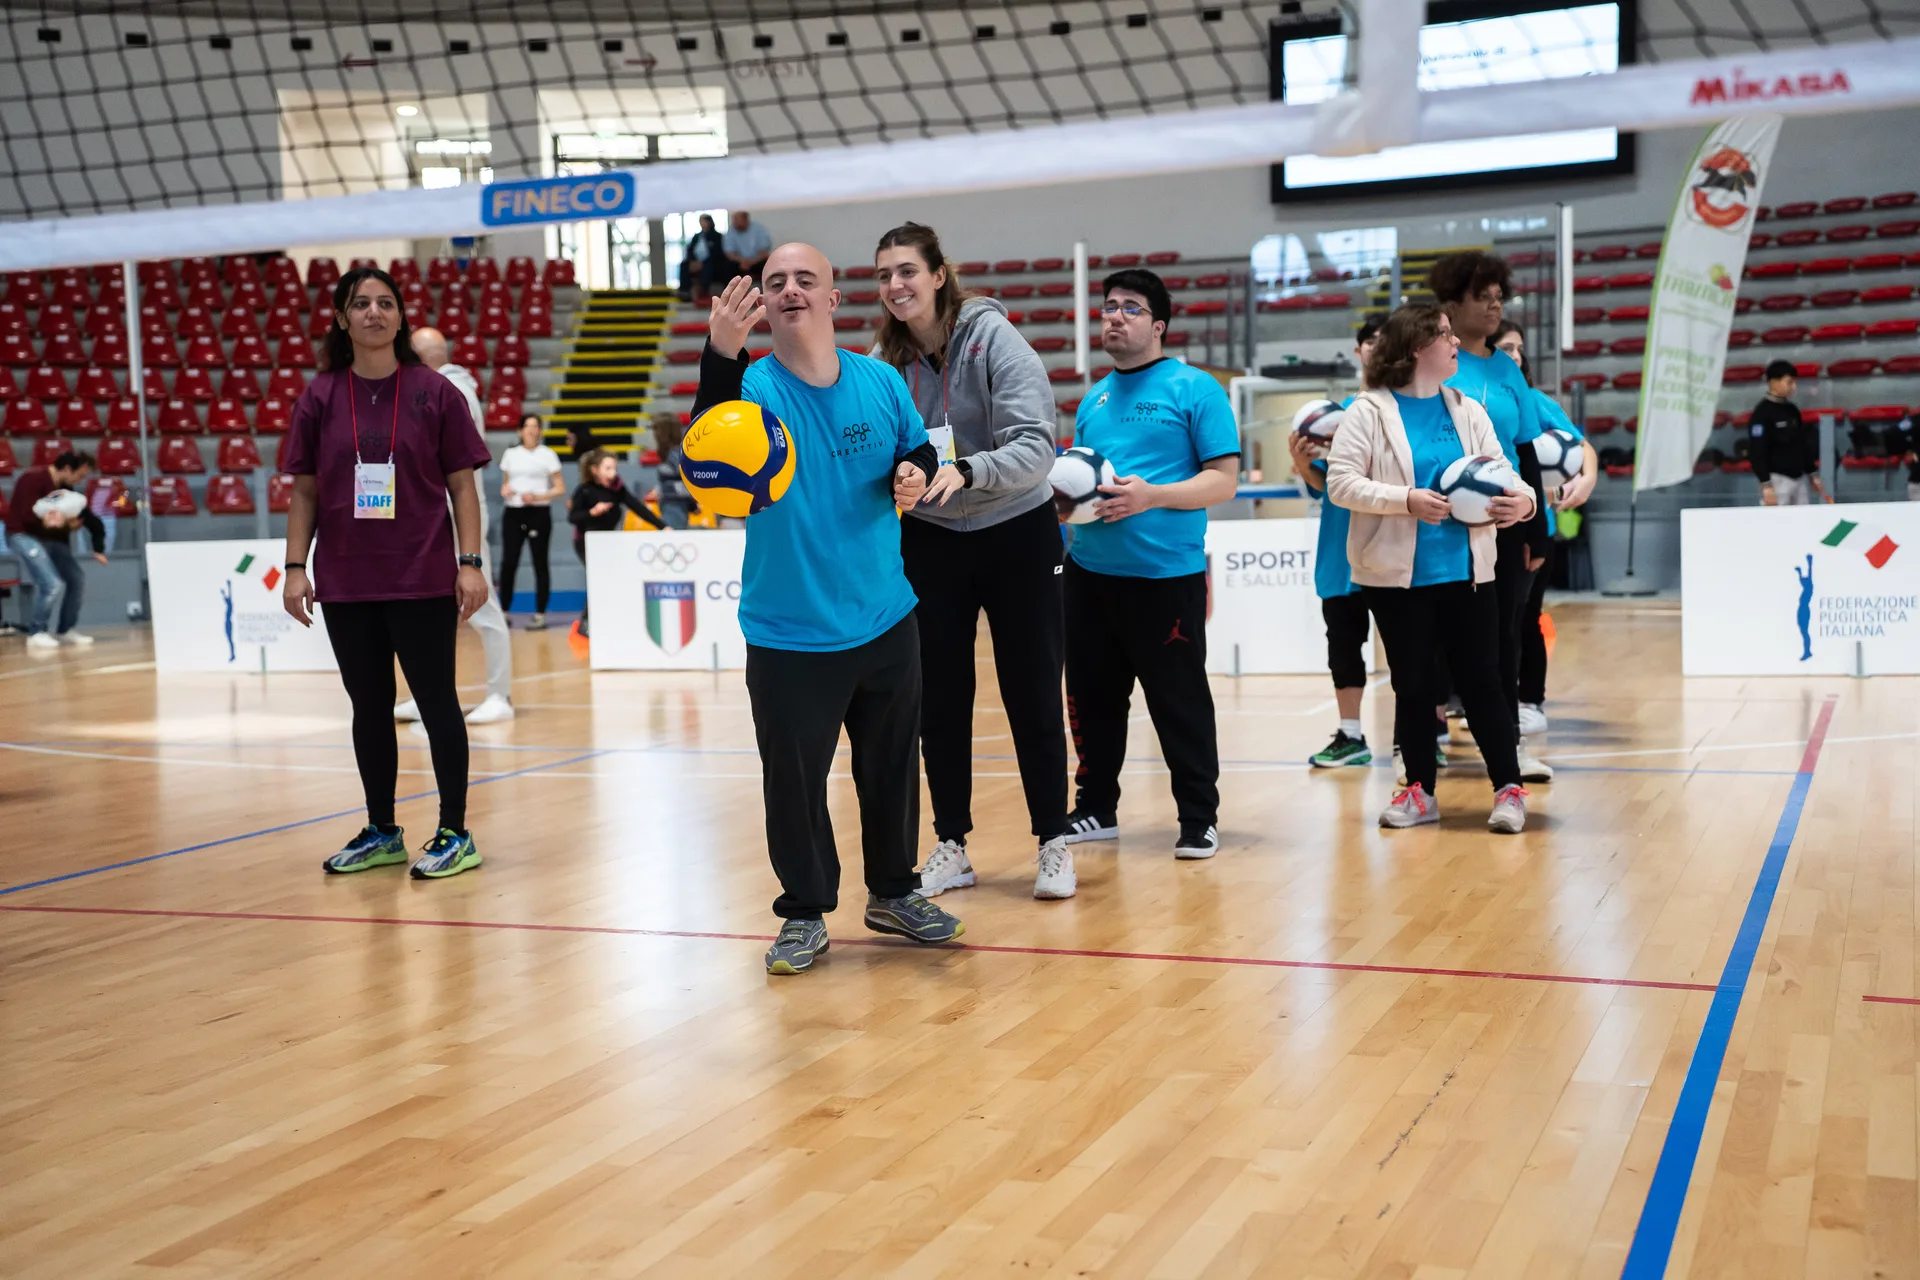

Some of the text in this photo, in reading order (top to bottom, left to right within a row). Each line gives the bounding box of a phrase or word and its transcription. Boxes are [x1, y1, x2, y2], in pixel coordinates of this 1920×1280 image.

[493, 180, 625, 218] FINECO
[693, 471, 718, 479] V200W
[357, 495, 392, 507] STAFF
[1226, 550, 1310, 571] SPORT
[1242, 572, 1311, 588] SALUTE
[647, 584, 692, 597] ITALIA
[1820, 596, 1918, 609] FEDERAZIONE
[1820, 610, 1908, 623] PUGILISTICA
[1820, 625, 1885, 637] ITALIANA
